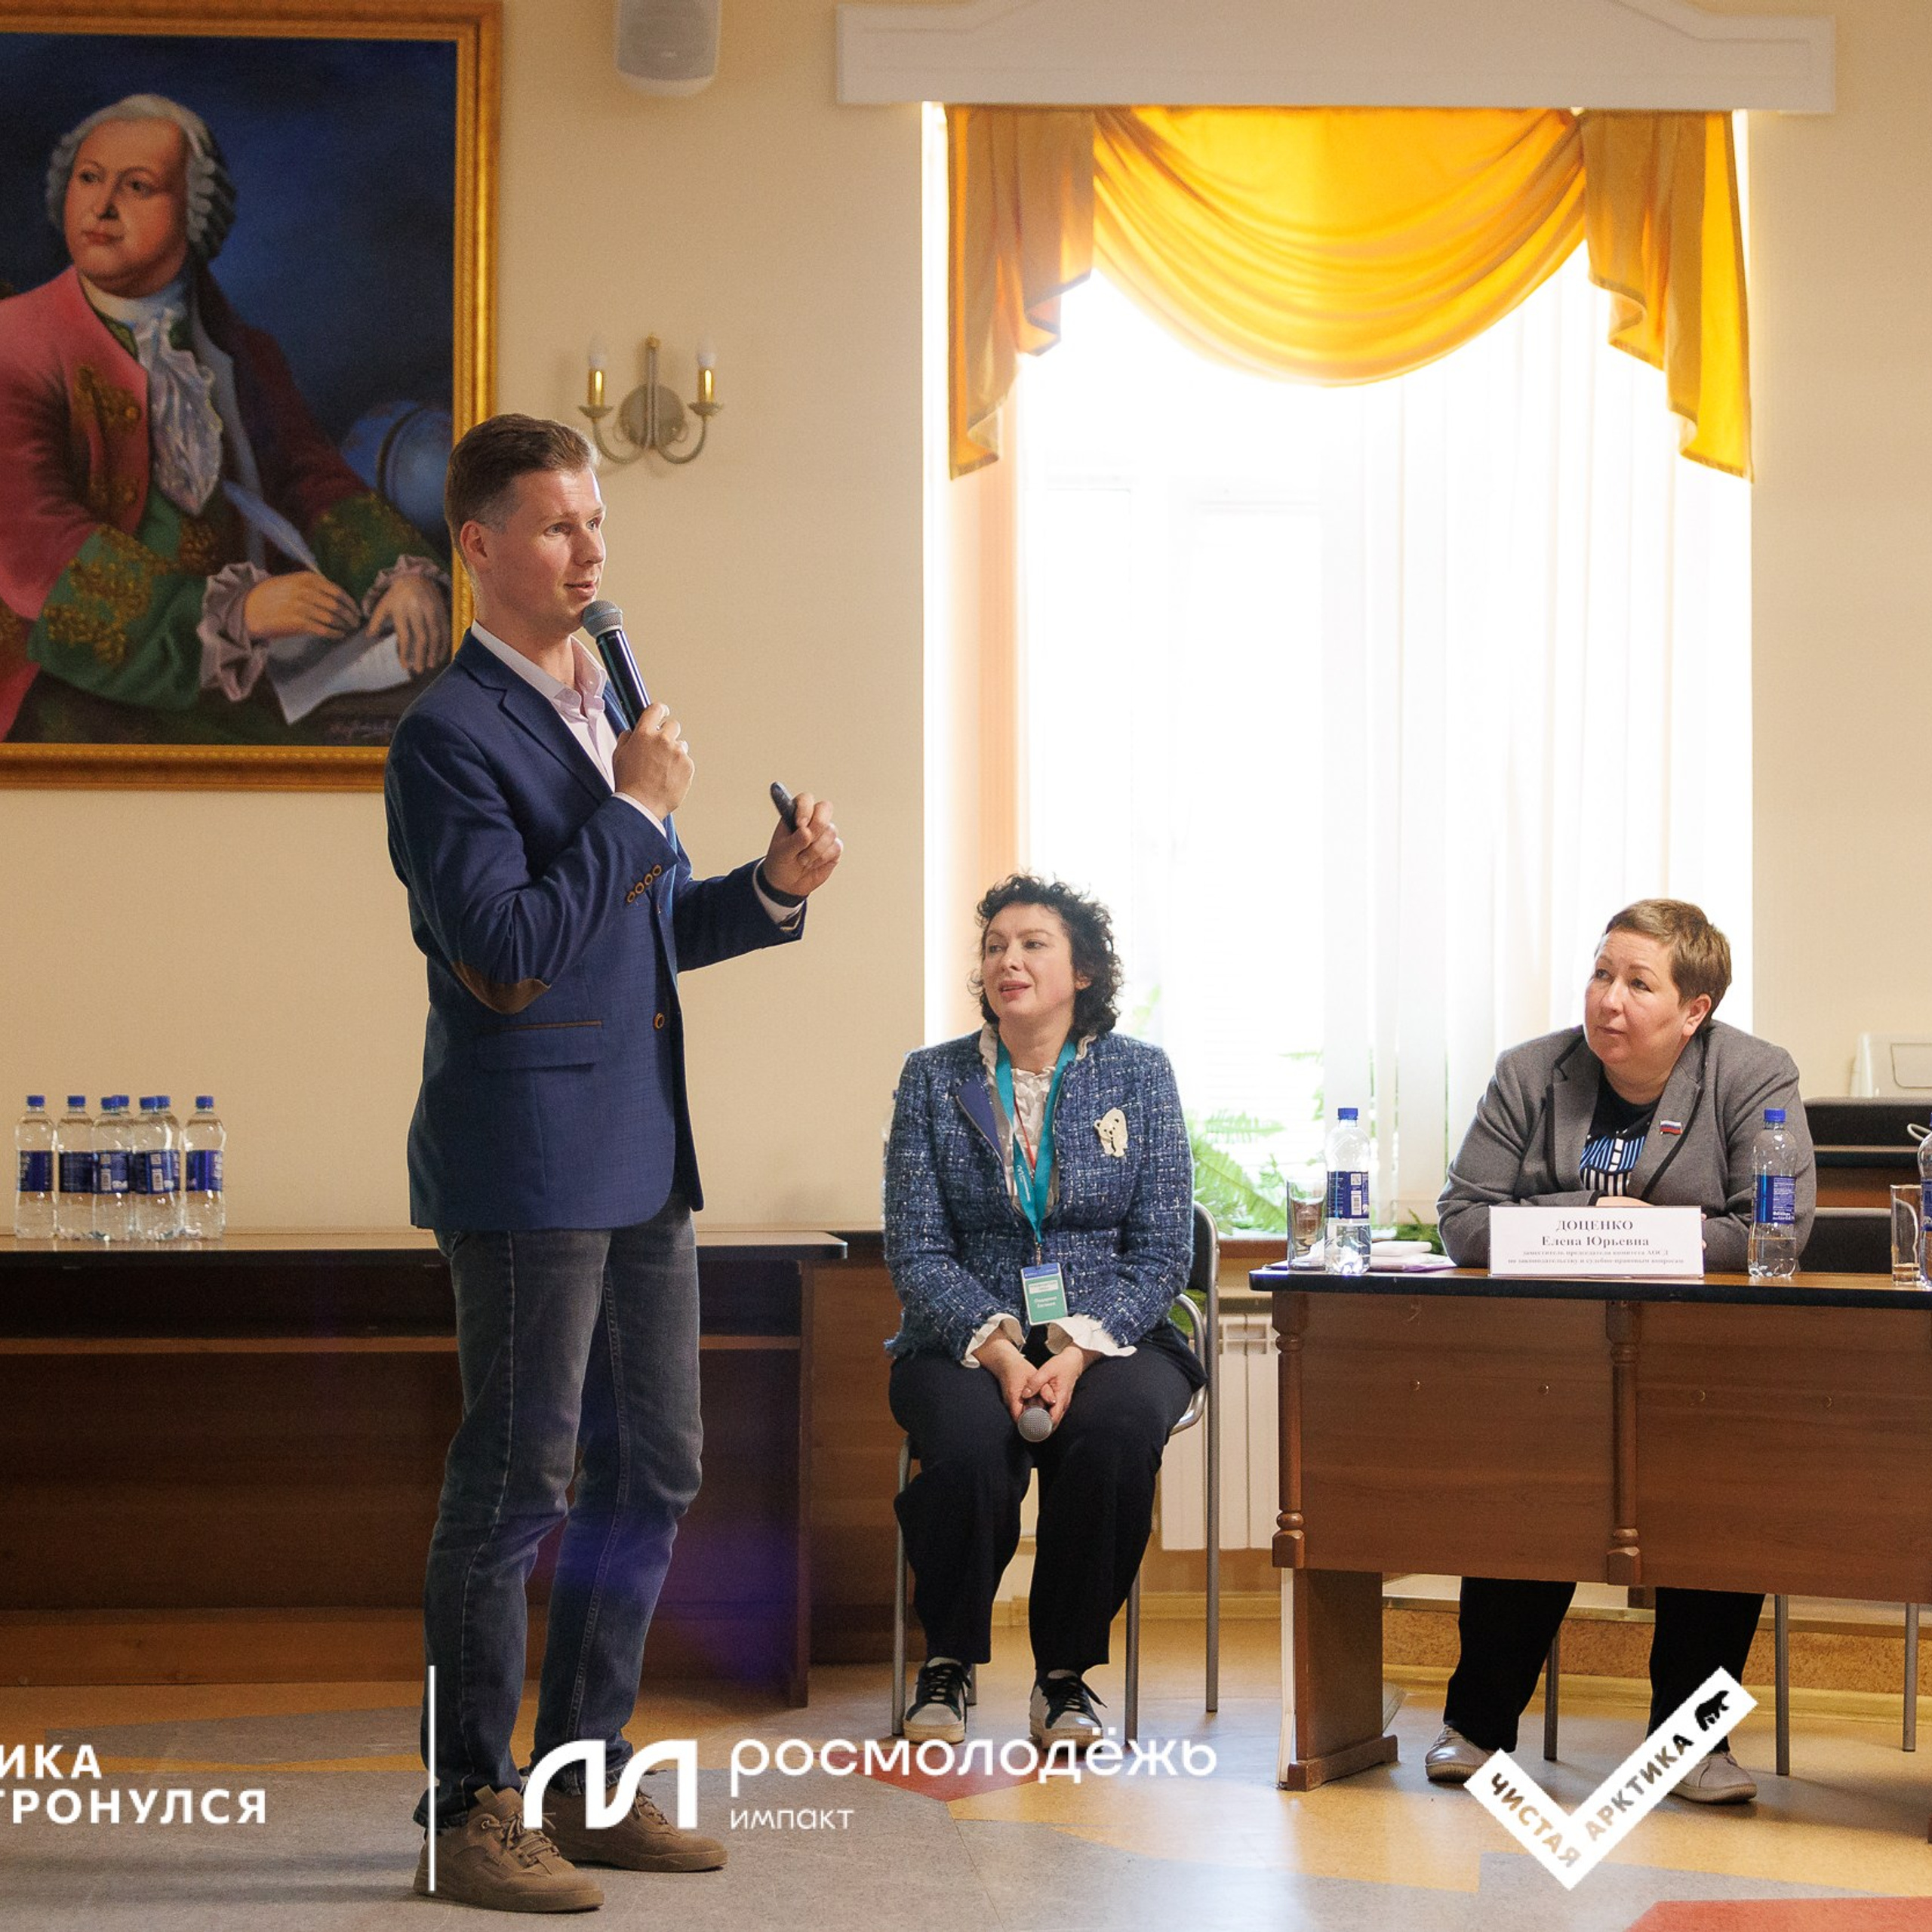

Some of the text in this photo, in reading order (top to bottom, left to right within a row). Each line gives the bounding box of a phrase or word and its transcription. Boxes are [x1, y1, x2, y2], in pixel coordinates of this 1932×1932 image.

[1555, 1220, 1634, 1232] ДОЦЕНКО
[1542, 1236, 1650, 1249] Елена Юрьевна
